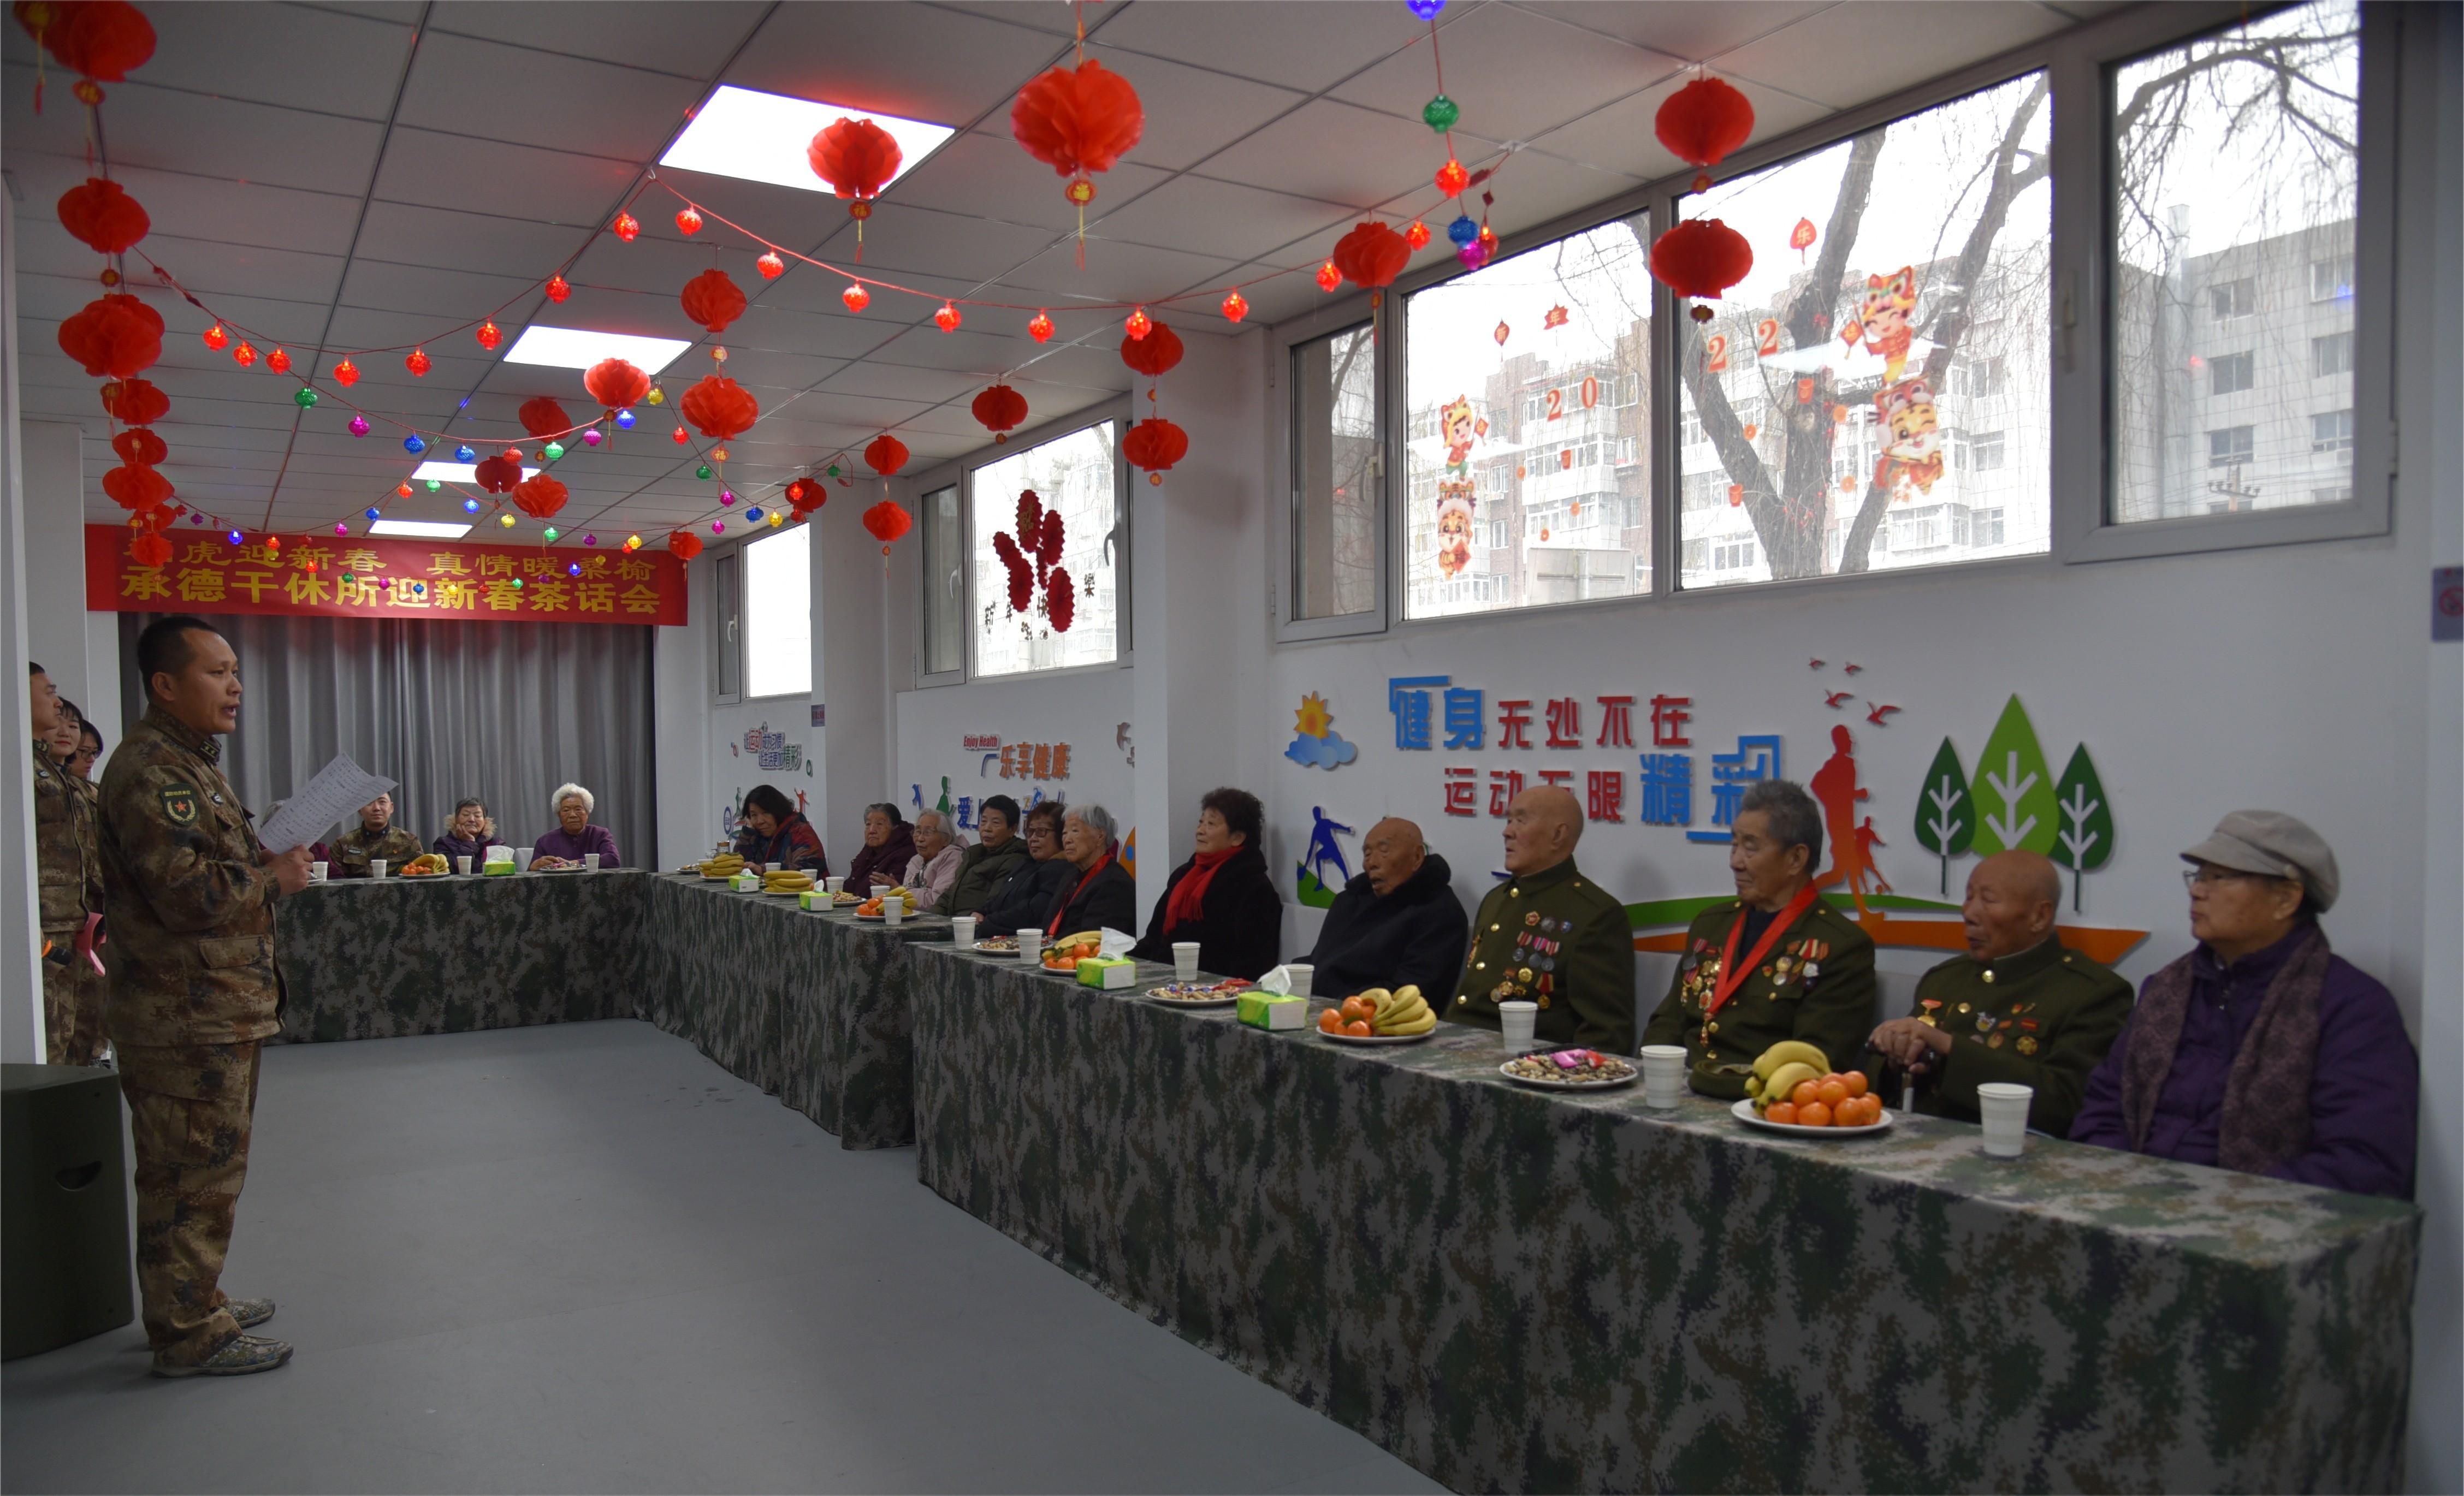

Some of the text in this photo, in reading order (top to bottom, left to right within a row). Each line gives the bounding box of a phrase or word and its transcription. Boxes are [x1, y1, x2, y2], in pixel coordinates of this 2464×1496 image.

[1797, 225, 1811, 246] 乐
[1550, 310, 1560, 324] 年
[123, 539, 387, 573] 虎迎新春
[121, 566, 660, 615] 承德干休所迎新春茶话会
[1393, 686, 1691, 747] 健身无处不在
[963, 735, 998, 749] Enjoy Health
[999, 741, 1069, 780] 乐享健康
